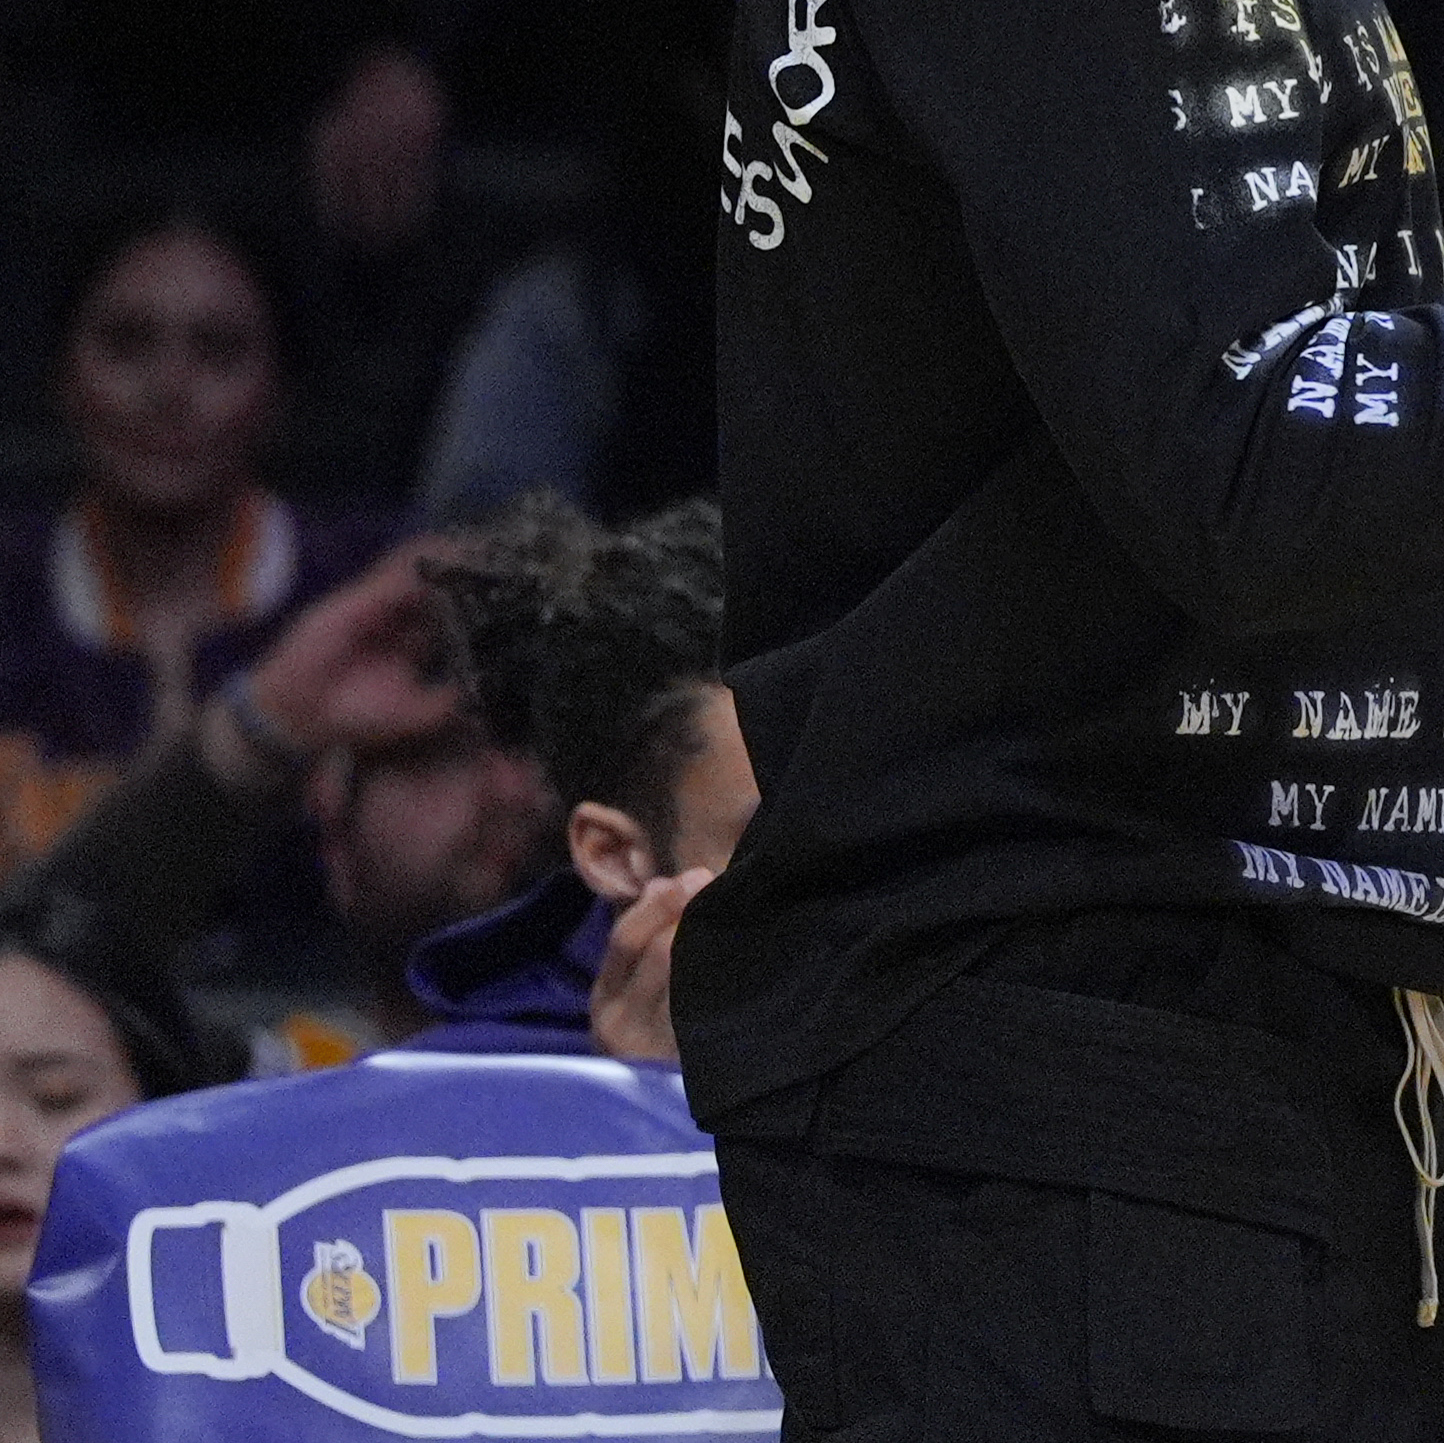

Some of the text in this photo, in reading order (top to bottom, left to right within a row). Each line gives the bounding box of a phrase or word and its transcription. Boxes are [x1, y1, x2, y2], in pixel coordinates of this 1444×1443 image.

[1224, 79, 1300, 129] MY
[1354, 353, 1400, 427] MY
[1292, 678, 1422, 741] NAME
[1267, 779, 1336, 832] MY
[1232, 838, 1305, 889] MY
[1306, 856, 1432, 917] NAME
[381, 1202, 774, 1387] PRIM
